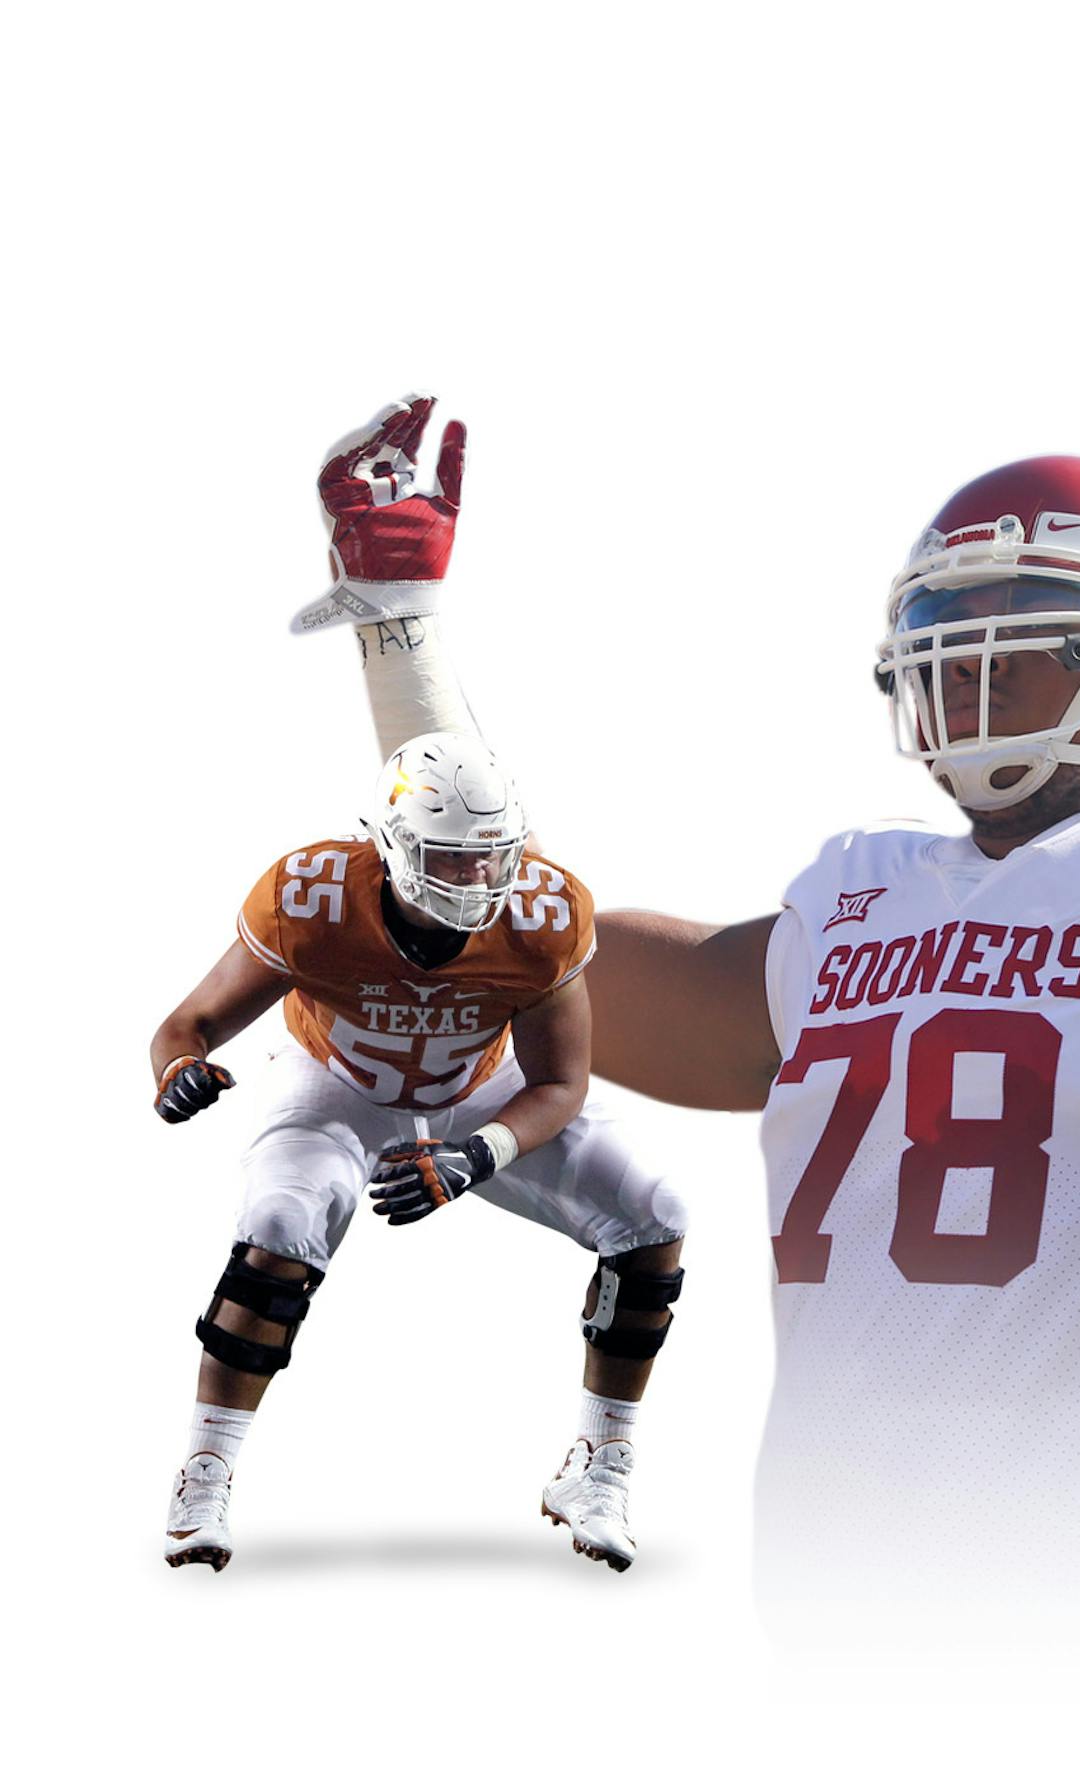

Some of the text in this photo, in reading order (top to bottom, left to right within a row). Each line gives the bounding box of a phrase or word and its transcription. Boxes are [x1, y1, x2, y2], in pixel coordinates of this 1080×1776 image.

[343, 594, 365, 615] 3XL
[281, 849, 348, 924] 55
[510, 861, 571, 932] 55
[361, 1001, 480, 1034] TEXAS
[327, 1014, 501, 1107] 55
[771, 1007, 1063, 1288] 78
